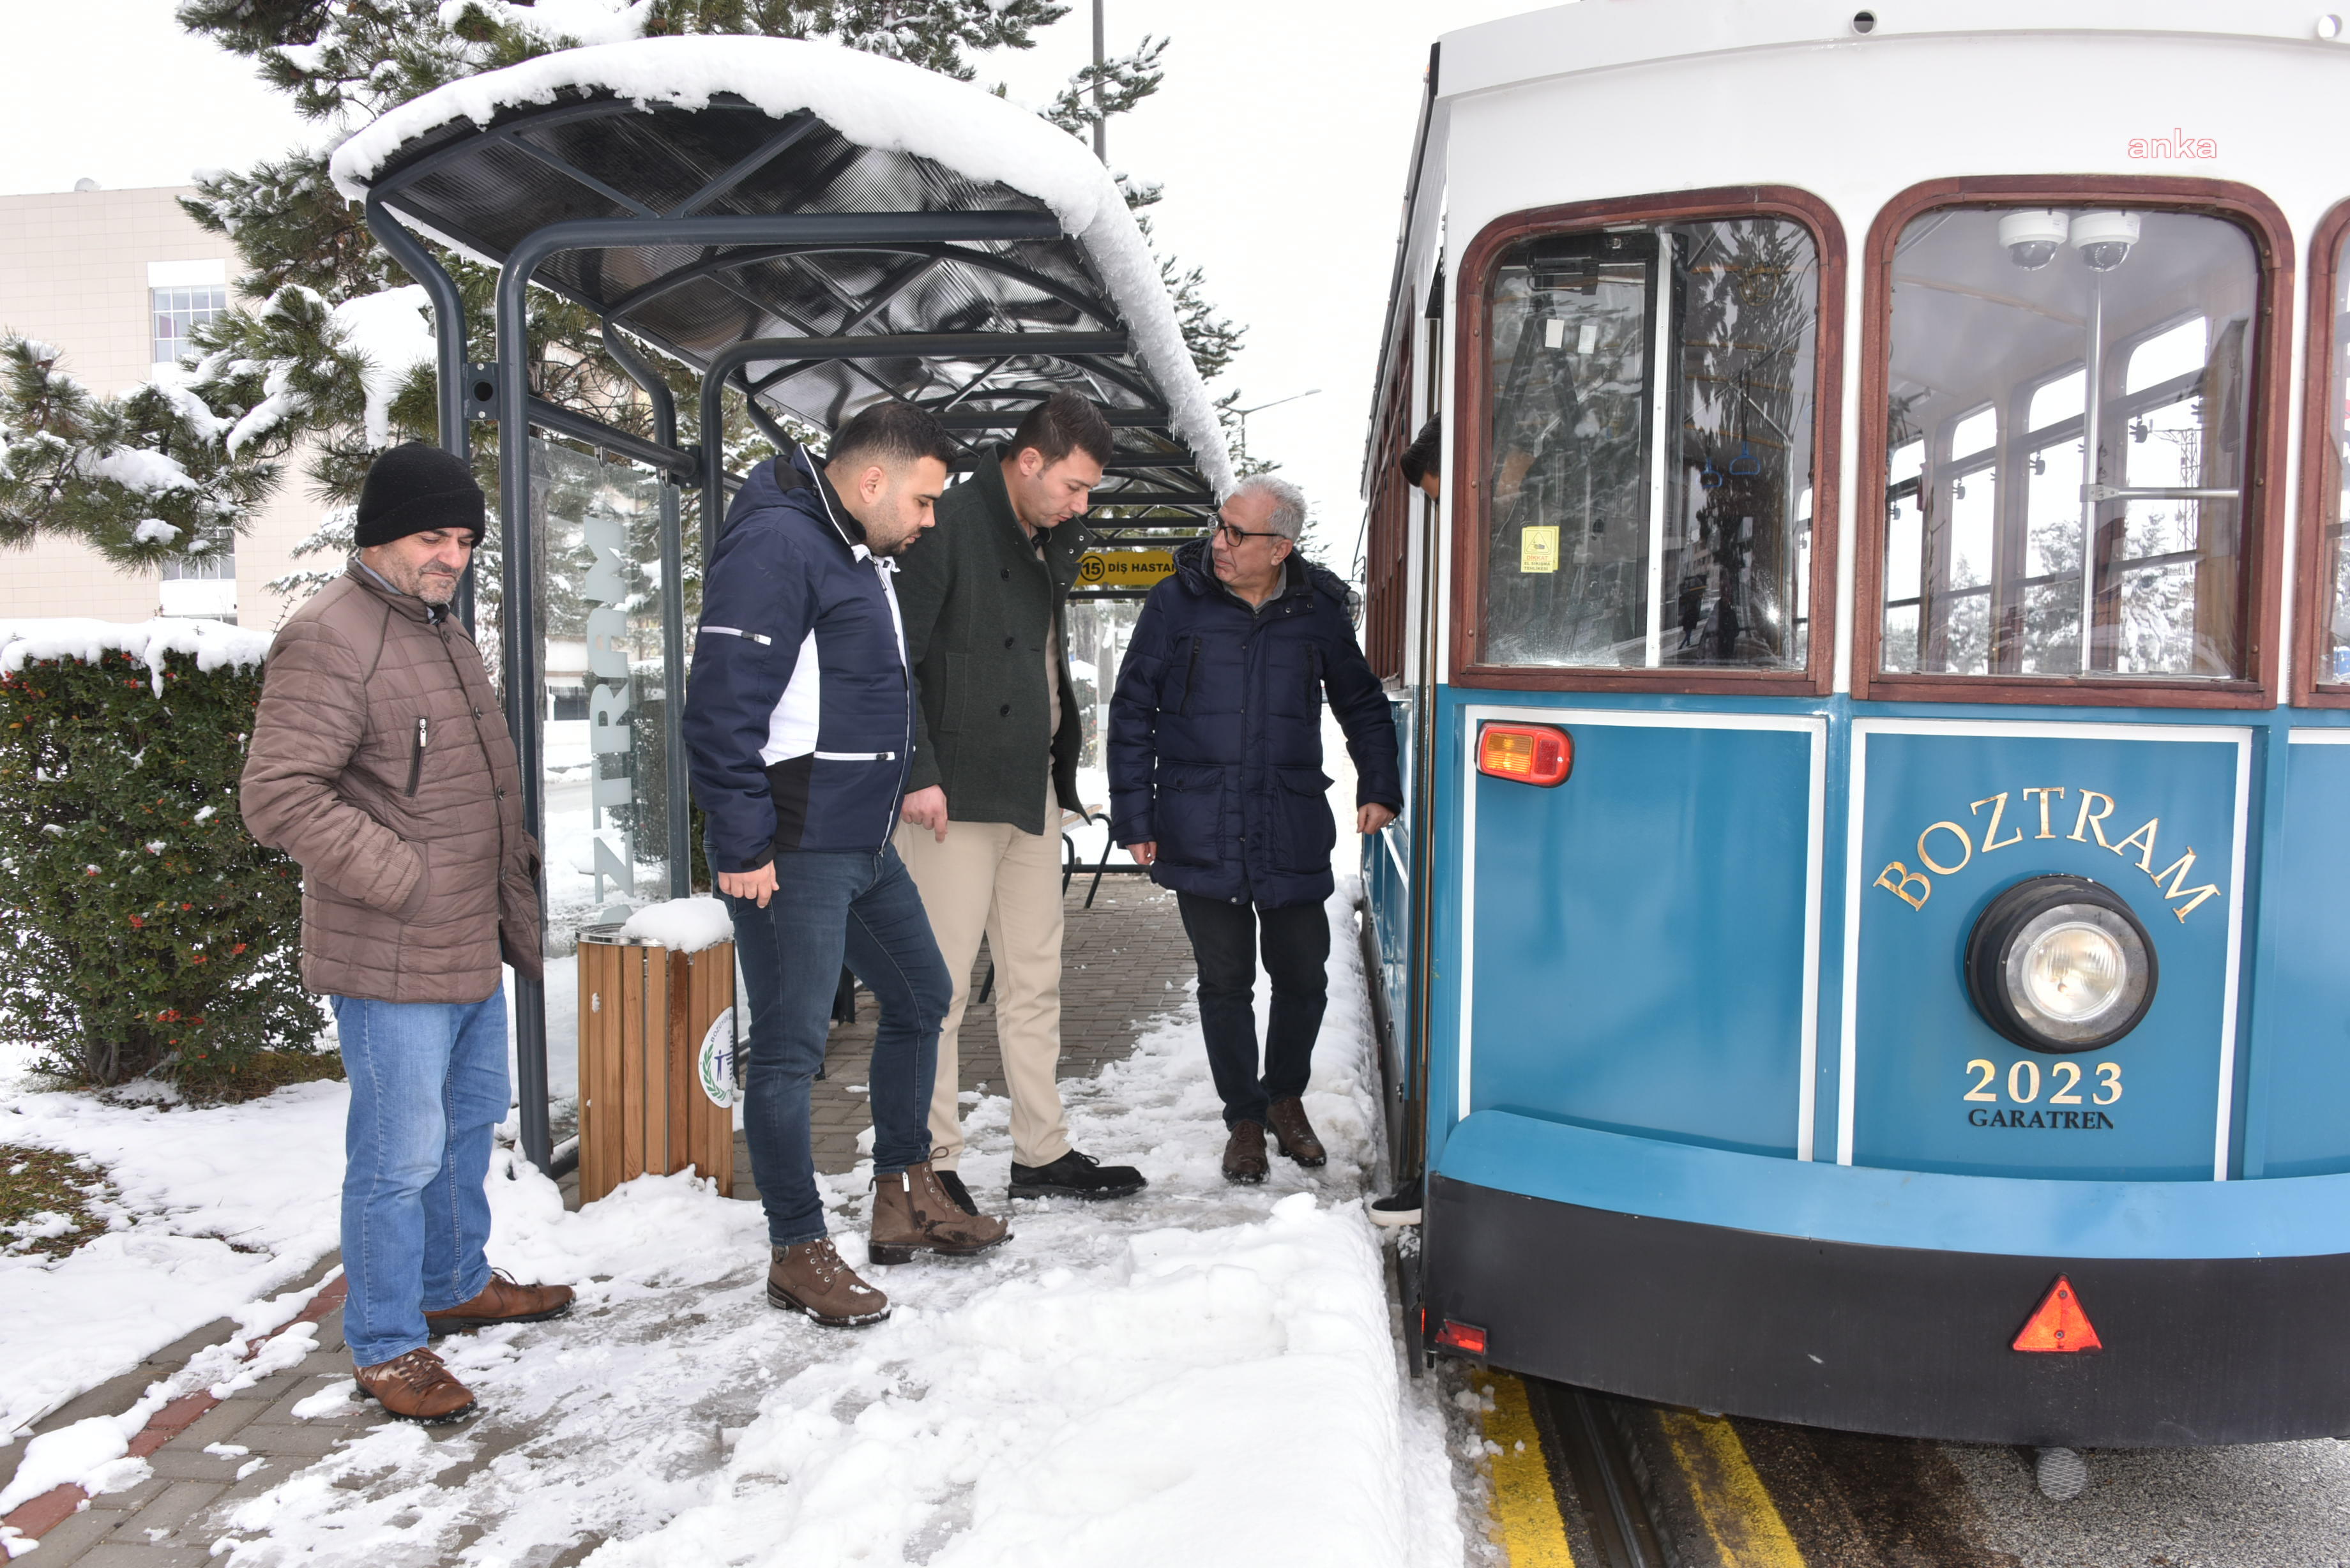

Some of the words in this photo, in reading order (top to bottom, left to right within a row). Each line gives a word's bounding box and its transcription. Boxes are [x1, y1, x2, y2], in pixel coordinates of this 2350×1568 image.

[1082, 562, 1101, 575] 15
[1108, 561, 1128, 575] DİŞ
[584, 516, 635, 925] ZTRAM
[1872, 787, 2221, 924] BOZTRAM
[1964, 1059, 2123, 1104] 2023
[1968, 1109, 2114, 1129] GARATREN
